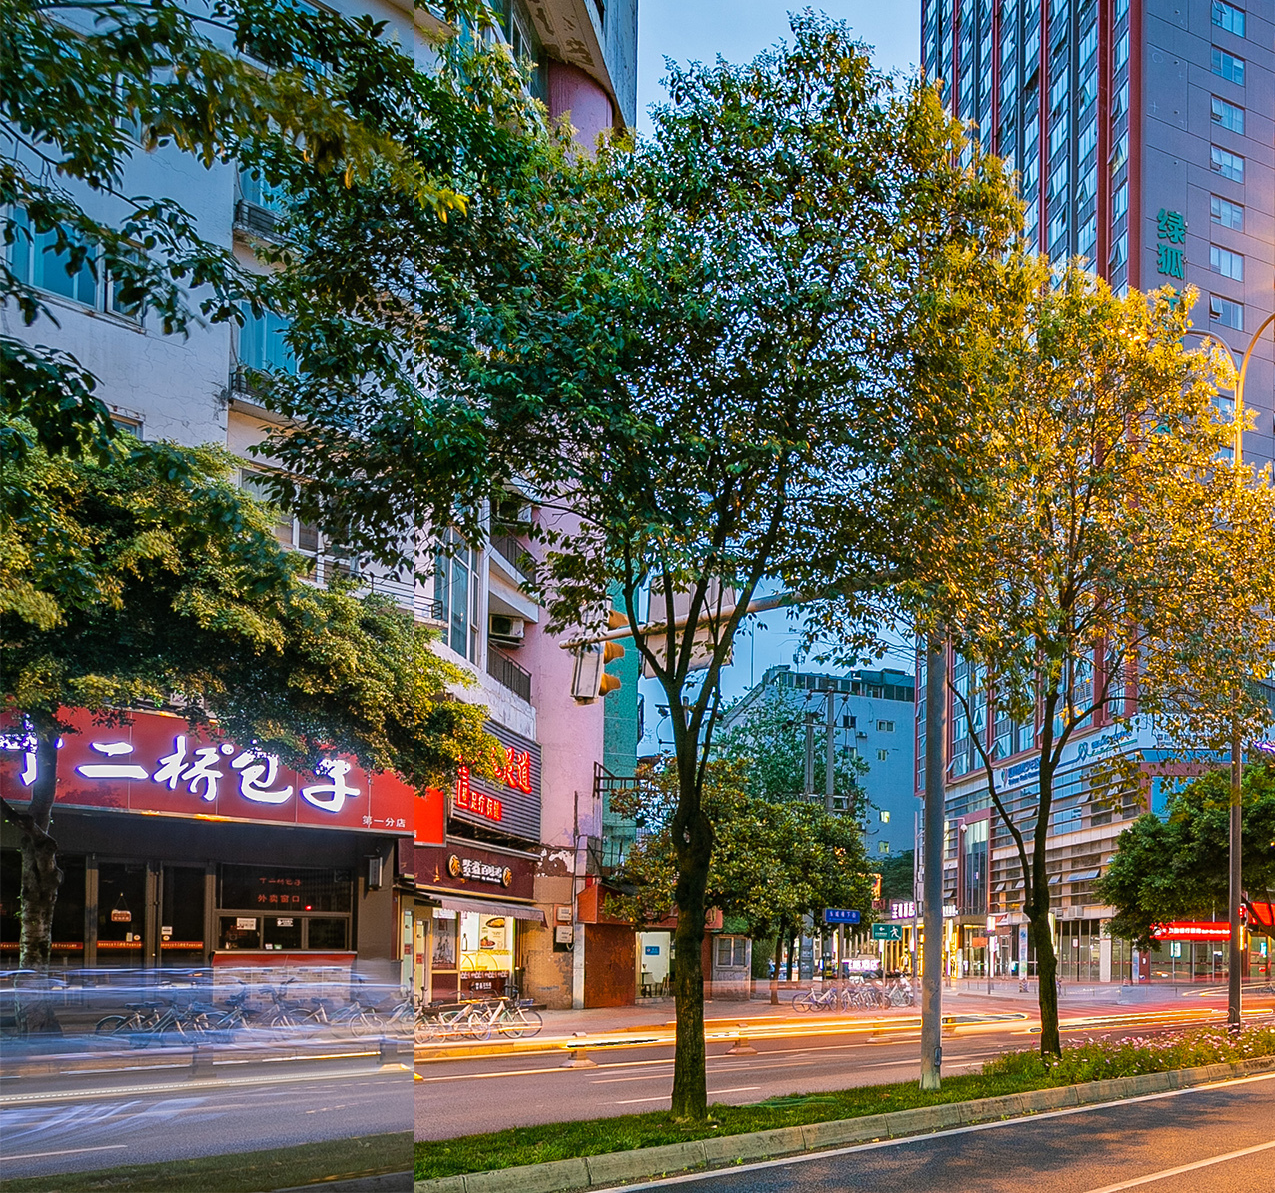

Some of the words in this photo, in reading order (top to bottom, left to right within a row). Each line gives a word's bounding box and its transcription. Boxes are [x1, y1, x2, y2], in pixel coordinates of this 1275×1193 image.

[362, 815, 406, 828] 第一分店
[257, 894, 301, 903] 外卖窗口
